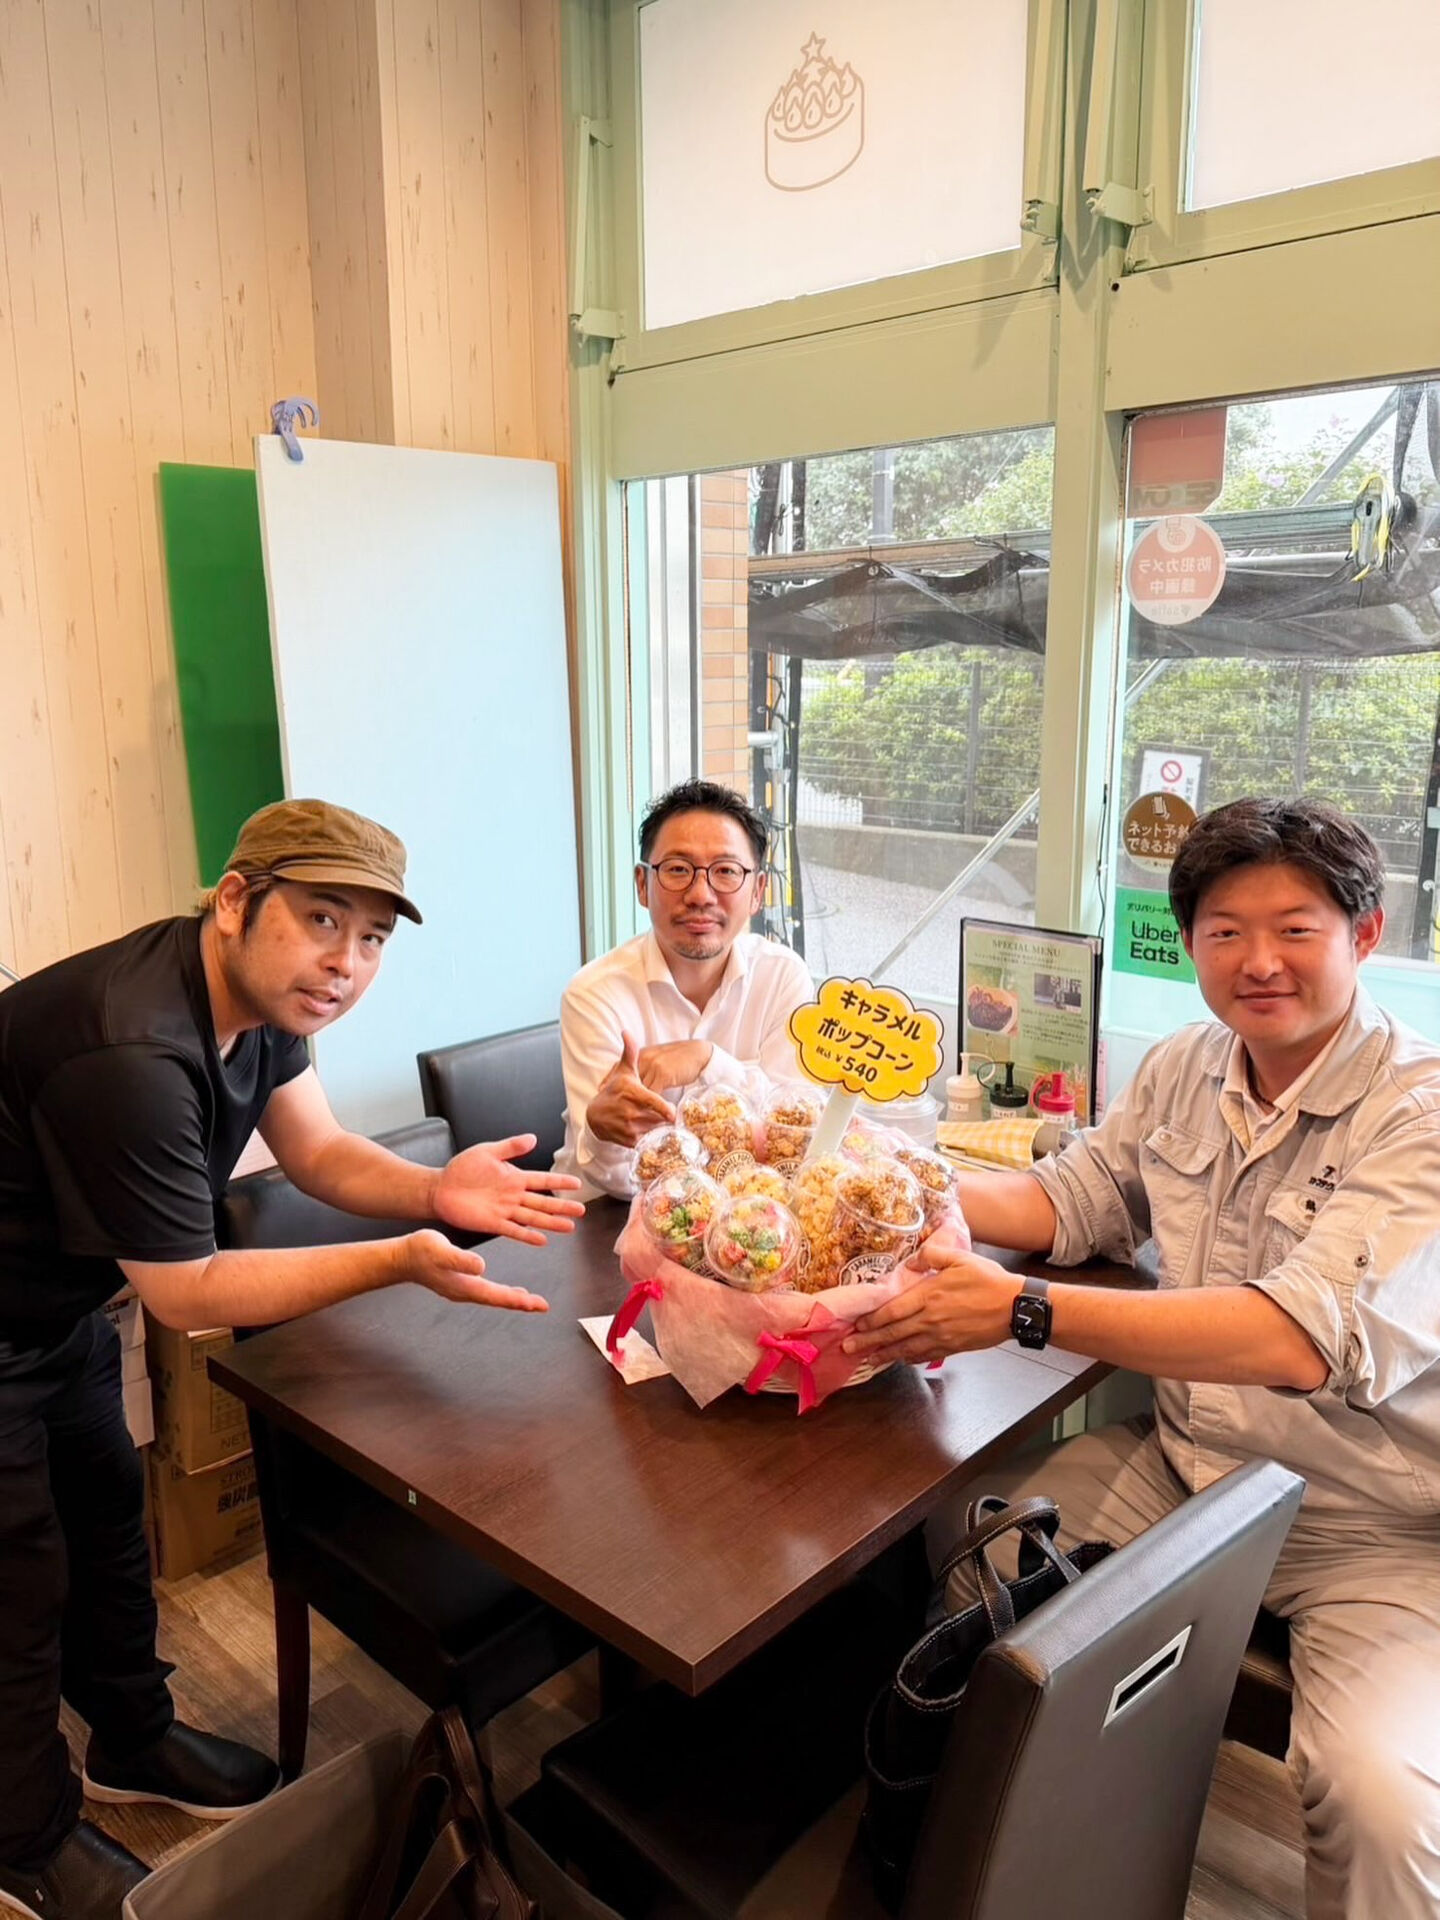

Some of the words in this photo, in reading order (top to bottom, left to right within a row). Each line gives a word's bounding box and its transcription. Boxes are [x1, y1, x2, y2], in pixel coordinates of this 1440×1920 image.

[1131, 920, 1181, 943] Uber
[1130, 942, 1180, 965] Eats
[840, 989, 921, 1041] キャラメル
[817, 1017, 914, 1071] ポップコーン
